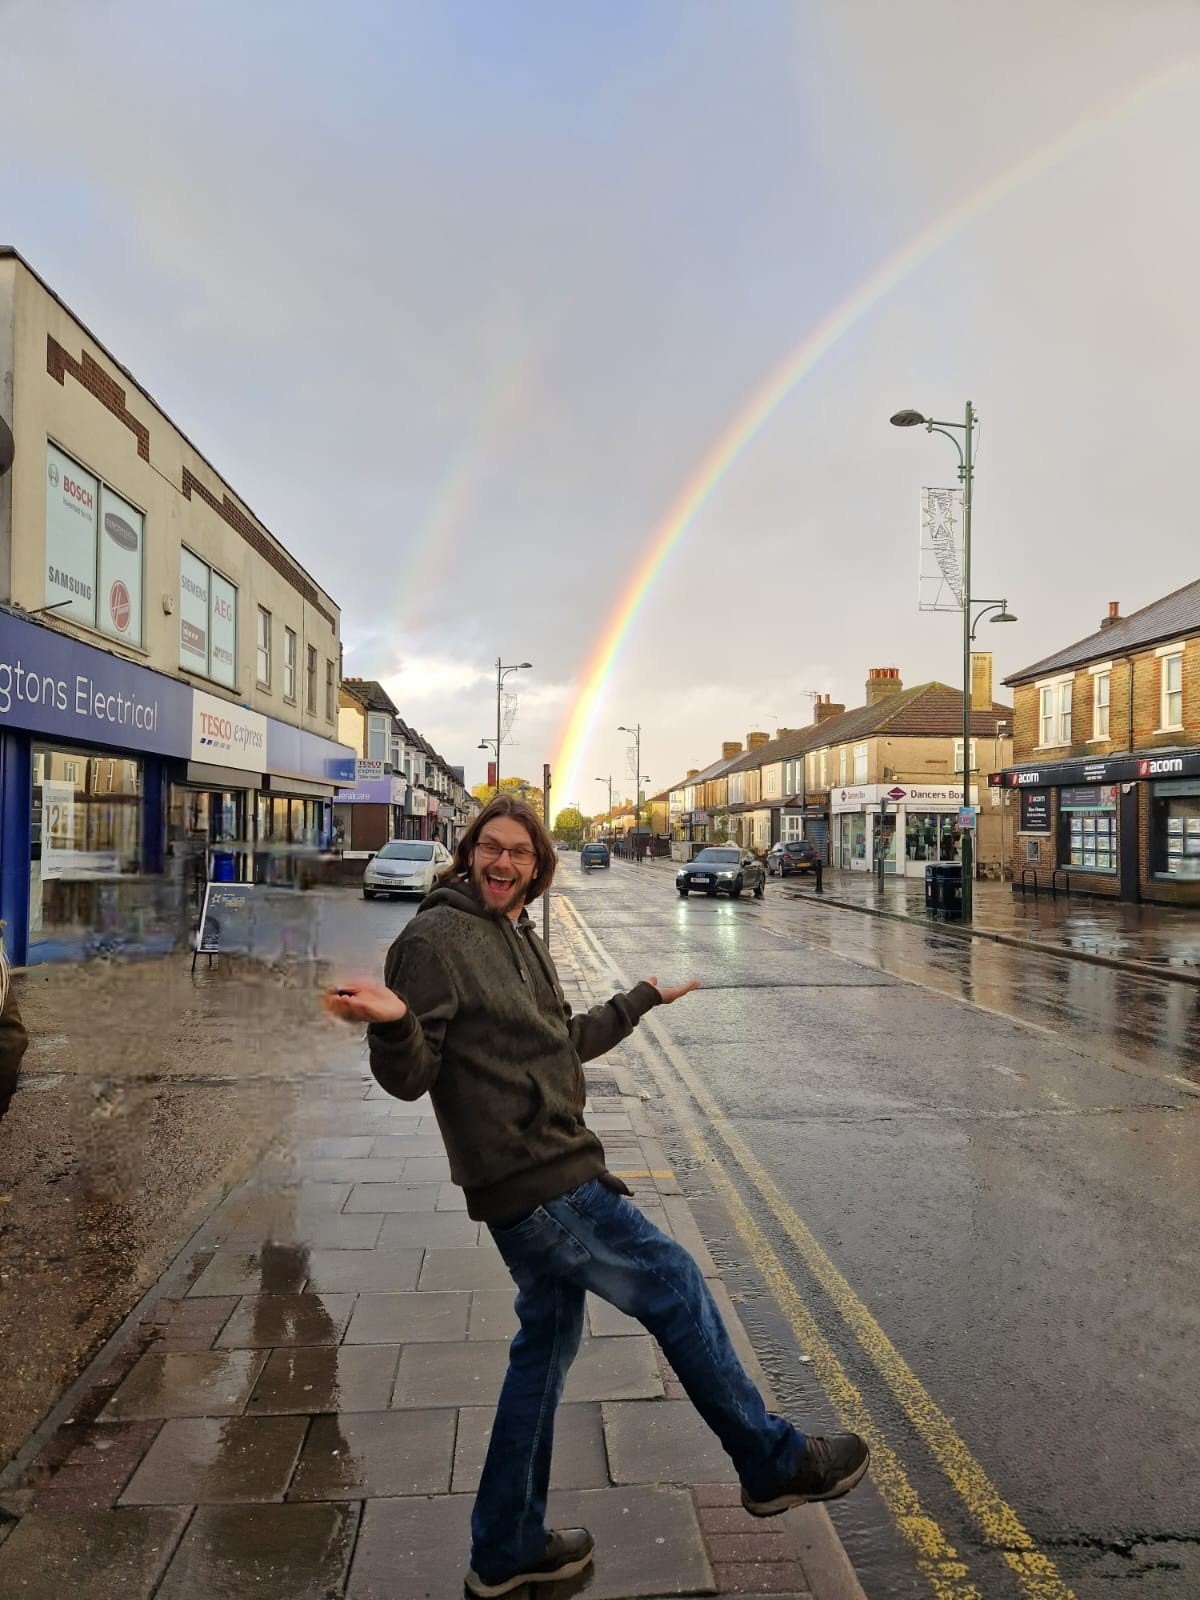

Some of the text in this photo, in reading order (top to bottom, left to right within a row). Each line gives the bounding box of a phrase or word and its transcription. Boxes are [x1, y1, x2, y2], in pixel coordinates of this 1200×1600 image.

[63, 476, 93, 507] BOSCH
[48, 566, 91, 600] SAMSUNG
[182, 575, 207, 602] SIEMENS
[214, 595, 233, 622] AEG
[75, 675, 158, 732] Electrical
[200, 711, 263, 752] TESCO express
[358, 760, 382, 768] TESCO
[1150, 758, 1183, 773] acorn
[1018, 772, 1039, 784] acorn
[910, 790, 946, 799] Dancers
